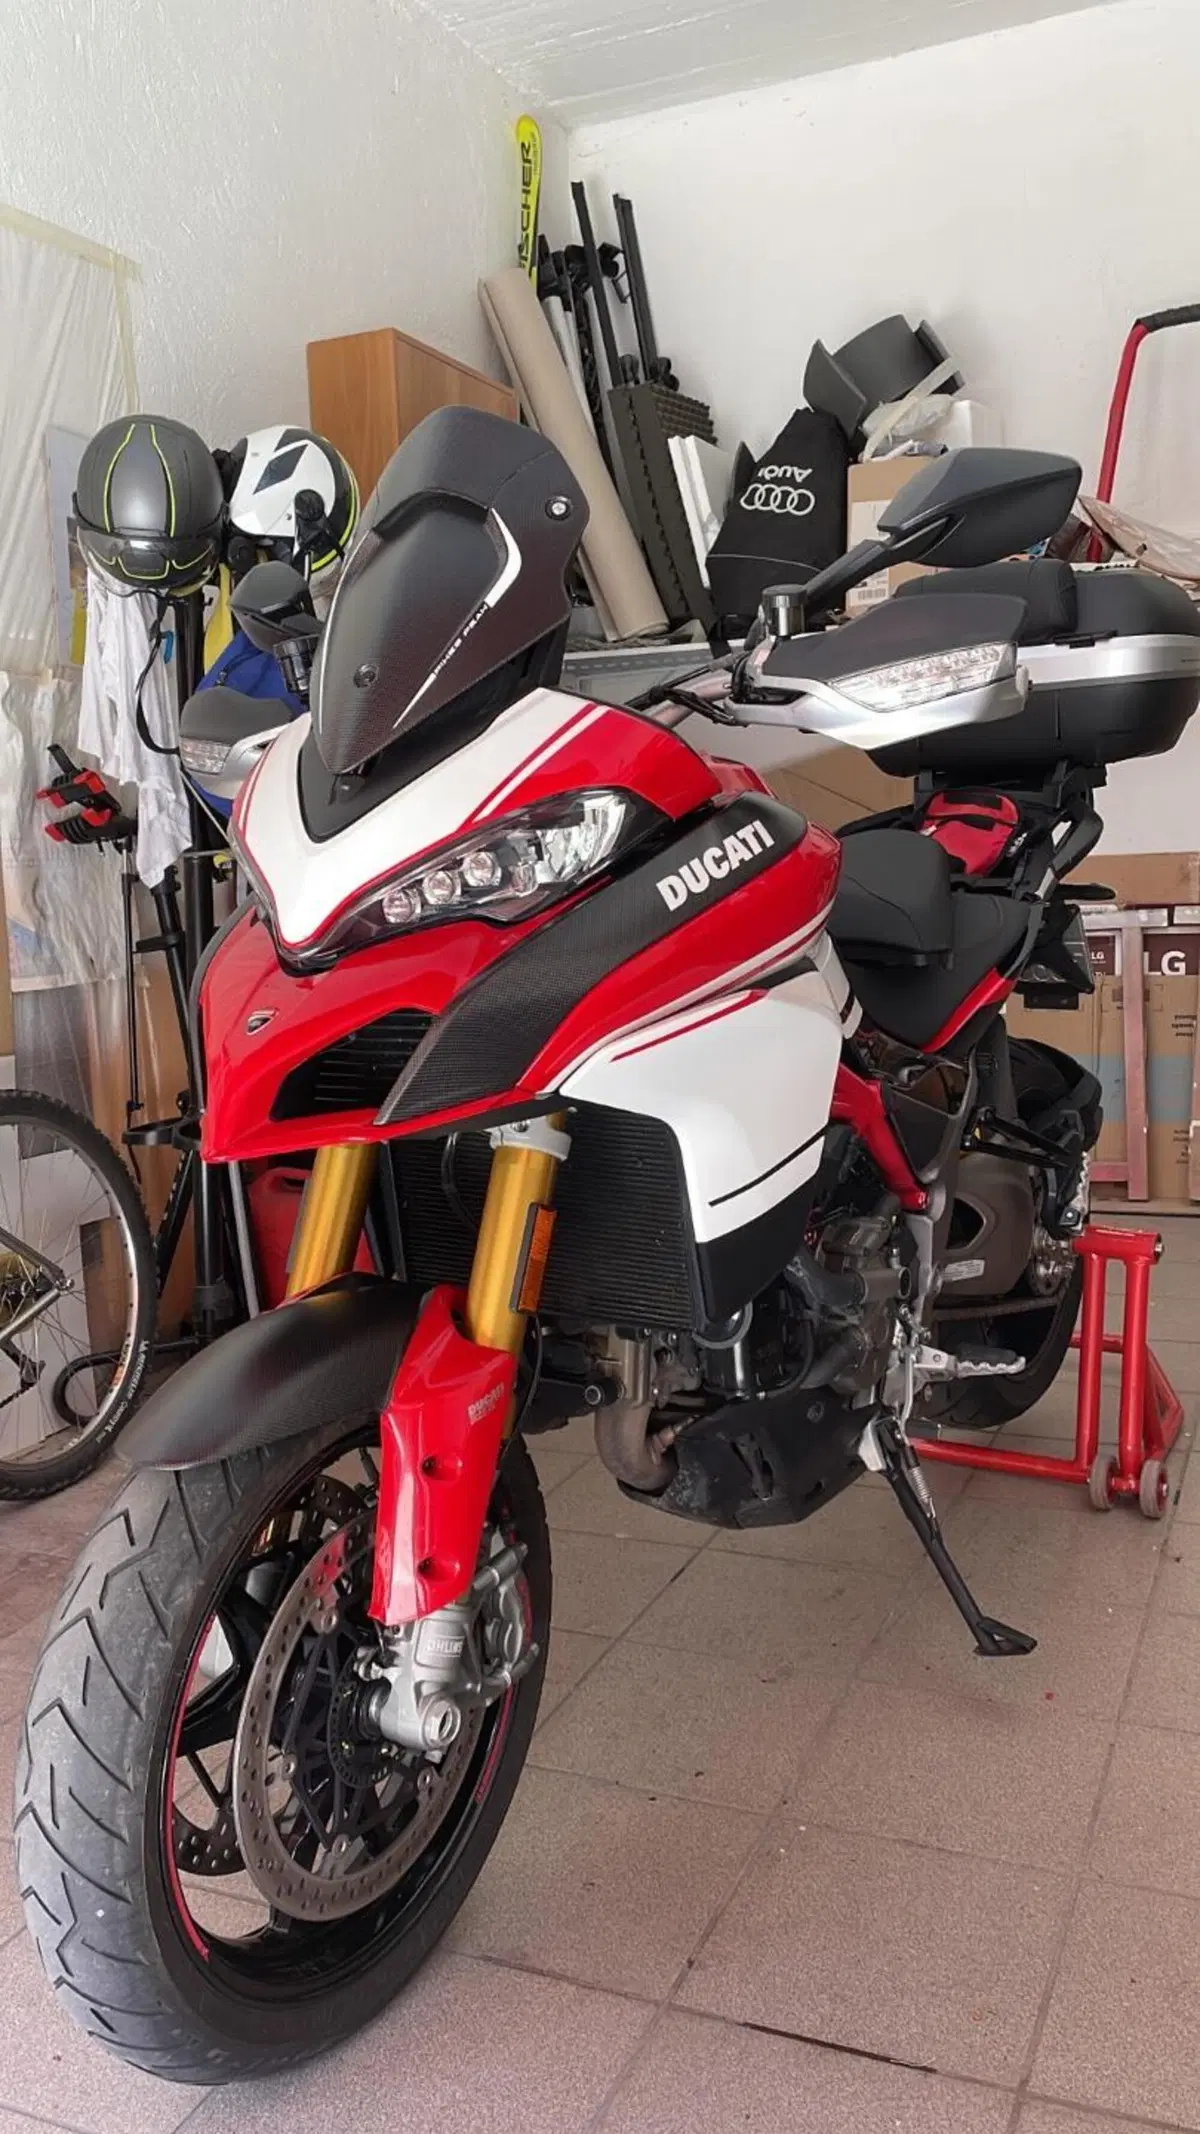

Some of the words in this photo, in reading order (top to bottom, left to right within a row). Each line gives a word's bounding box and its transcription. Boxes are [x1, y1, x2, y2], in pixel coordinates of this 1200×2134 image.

[757, 464, 813, 483] Audi
[462, 603, 489, 637] PEAK
[655, 819, 776, 912] DUCATI
[1143, 950, 1186, 976] LG
